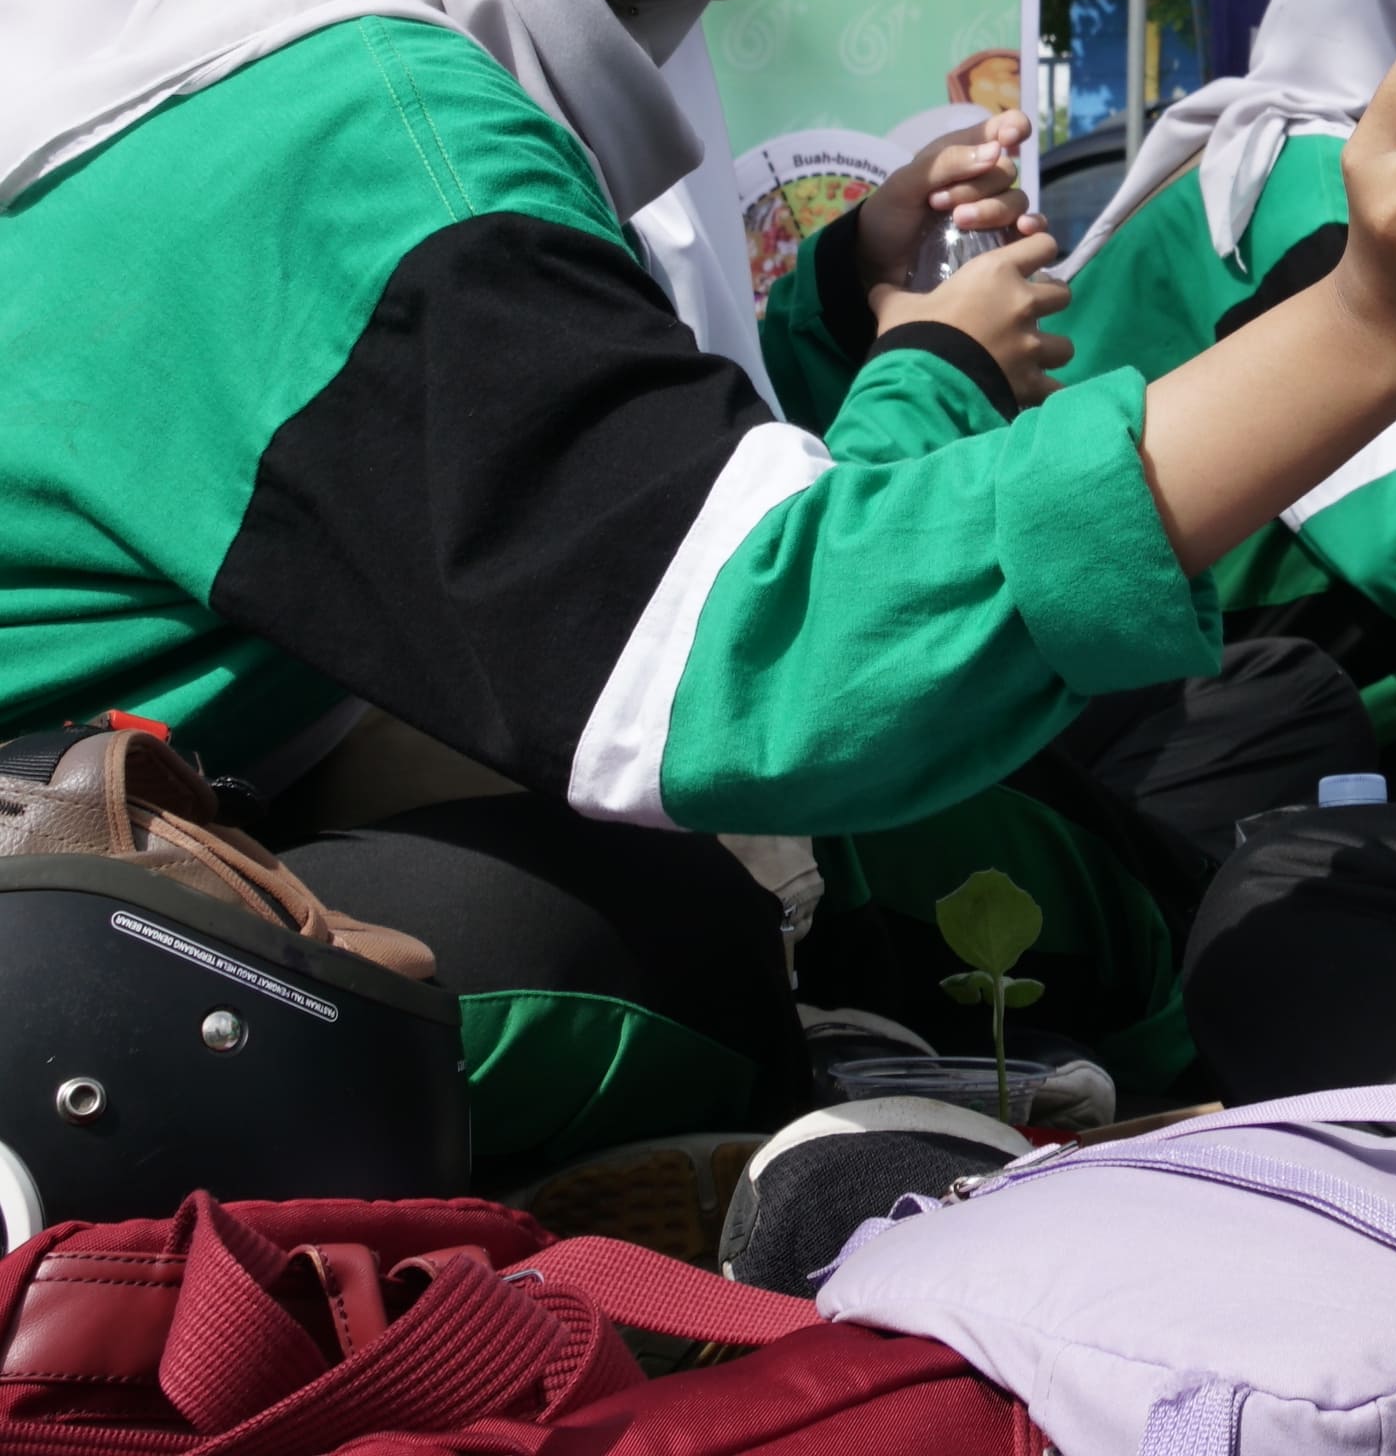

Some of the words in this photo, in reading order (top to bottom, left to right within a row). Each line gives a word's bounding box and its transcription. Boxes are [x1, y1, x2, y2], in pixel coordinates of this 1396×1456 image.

[793, 152, 888, 180] Buah-buahan
[115, 915, 143, 933] BENAR
[142, 927, 173, 946] DENGAN
[173, 939, 217, 965] TERPASANG
[216, 958, 237, 974] HELM
[236, 967, 258, 984] DAGU
[257, 977, 290, 998] PENGIKAT
[291, 991, 305, 1005] TALI
[305, 1000, 336, 1018] PASTIKAN
